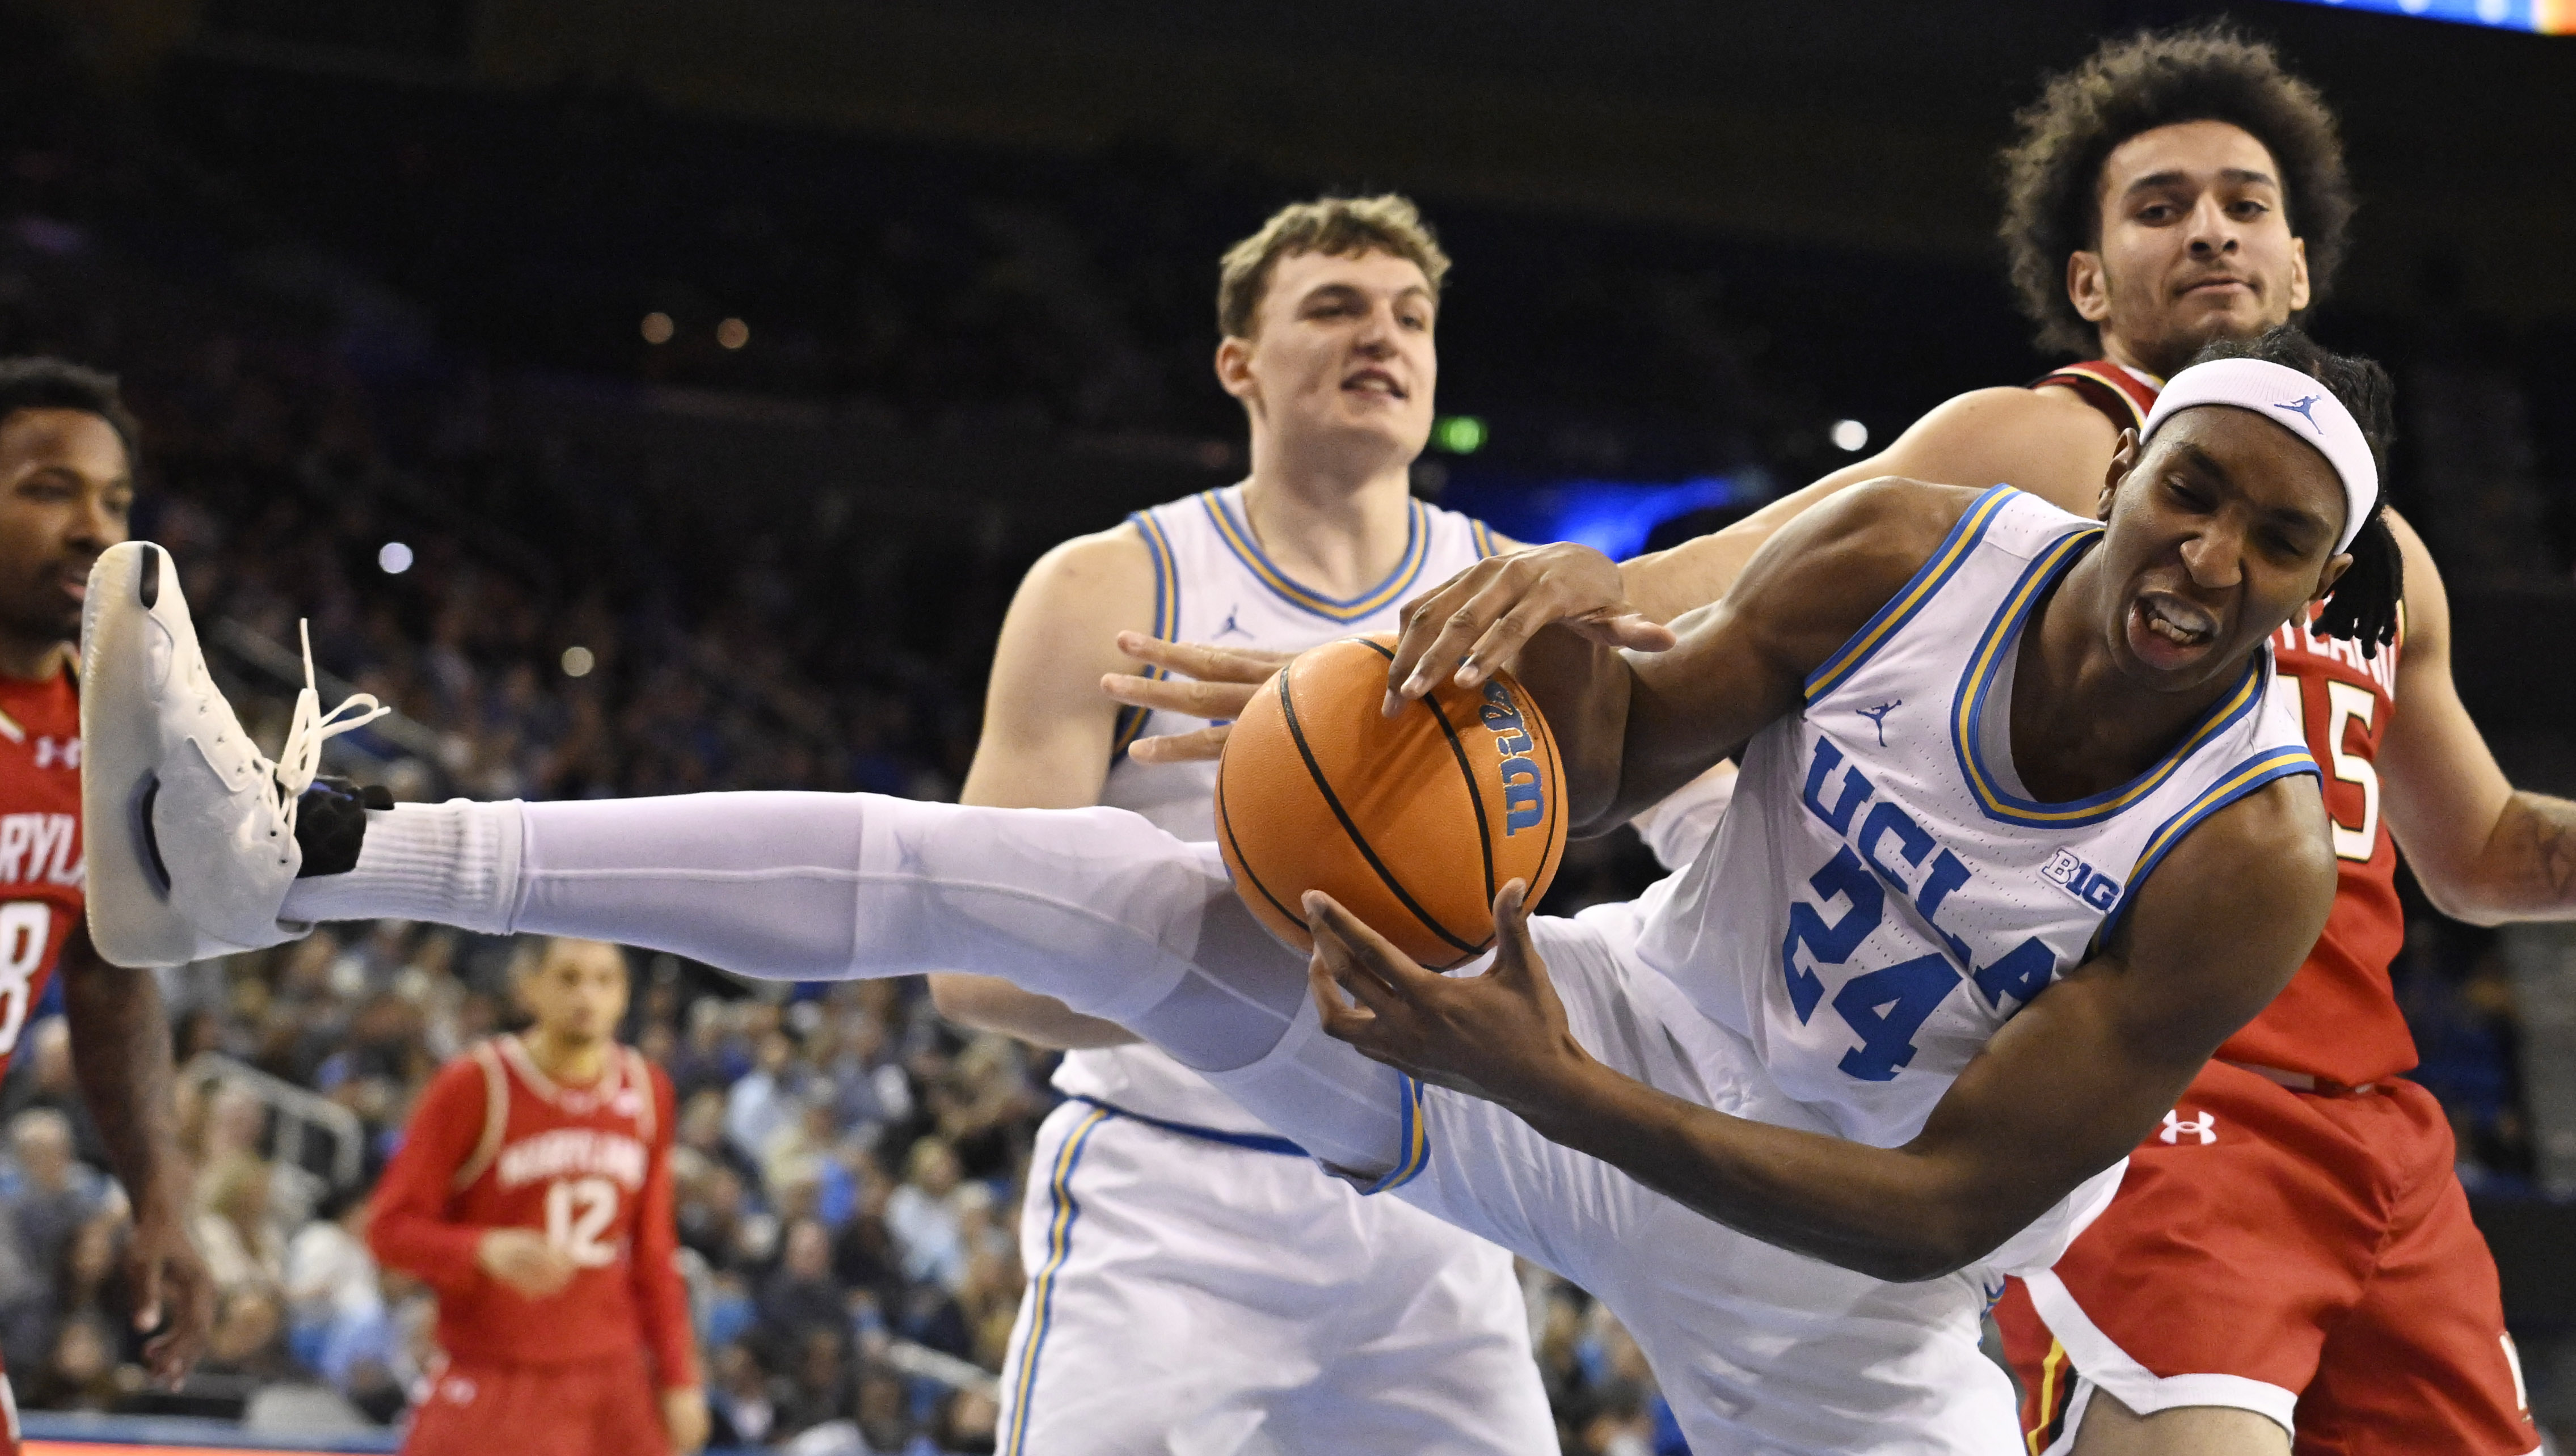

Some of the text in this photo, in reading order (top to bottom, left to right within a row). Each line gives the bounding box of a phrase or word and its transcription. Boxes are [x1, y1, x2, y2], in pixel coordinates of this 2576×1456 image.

[0, 813, 86, 891] RYL
[1804, 736, 2056, 1021] UCLA
[1783, 844, 1964, 1081] 24
[546, 1176, 618, 1268] 12
